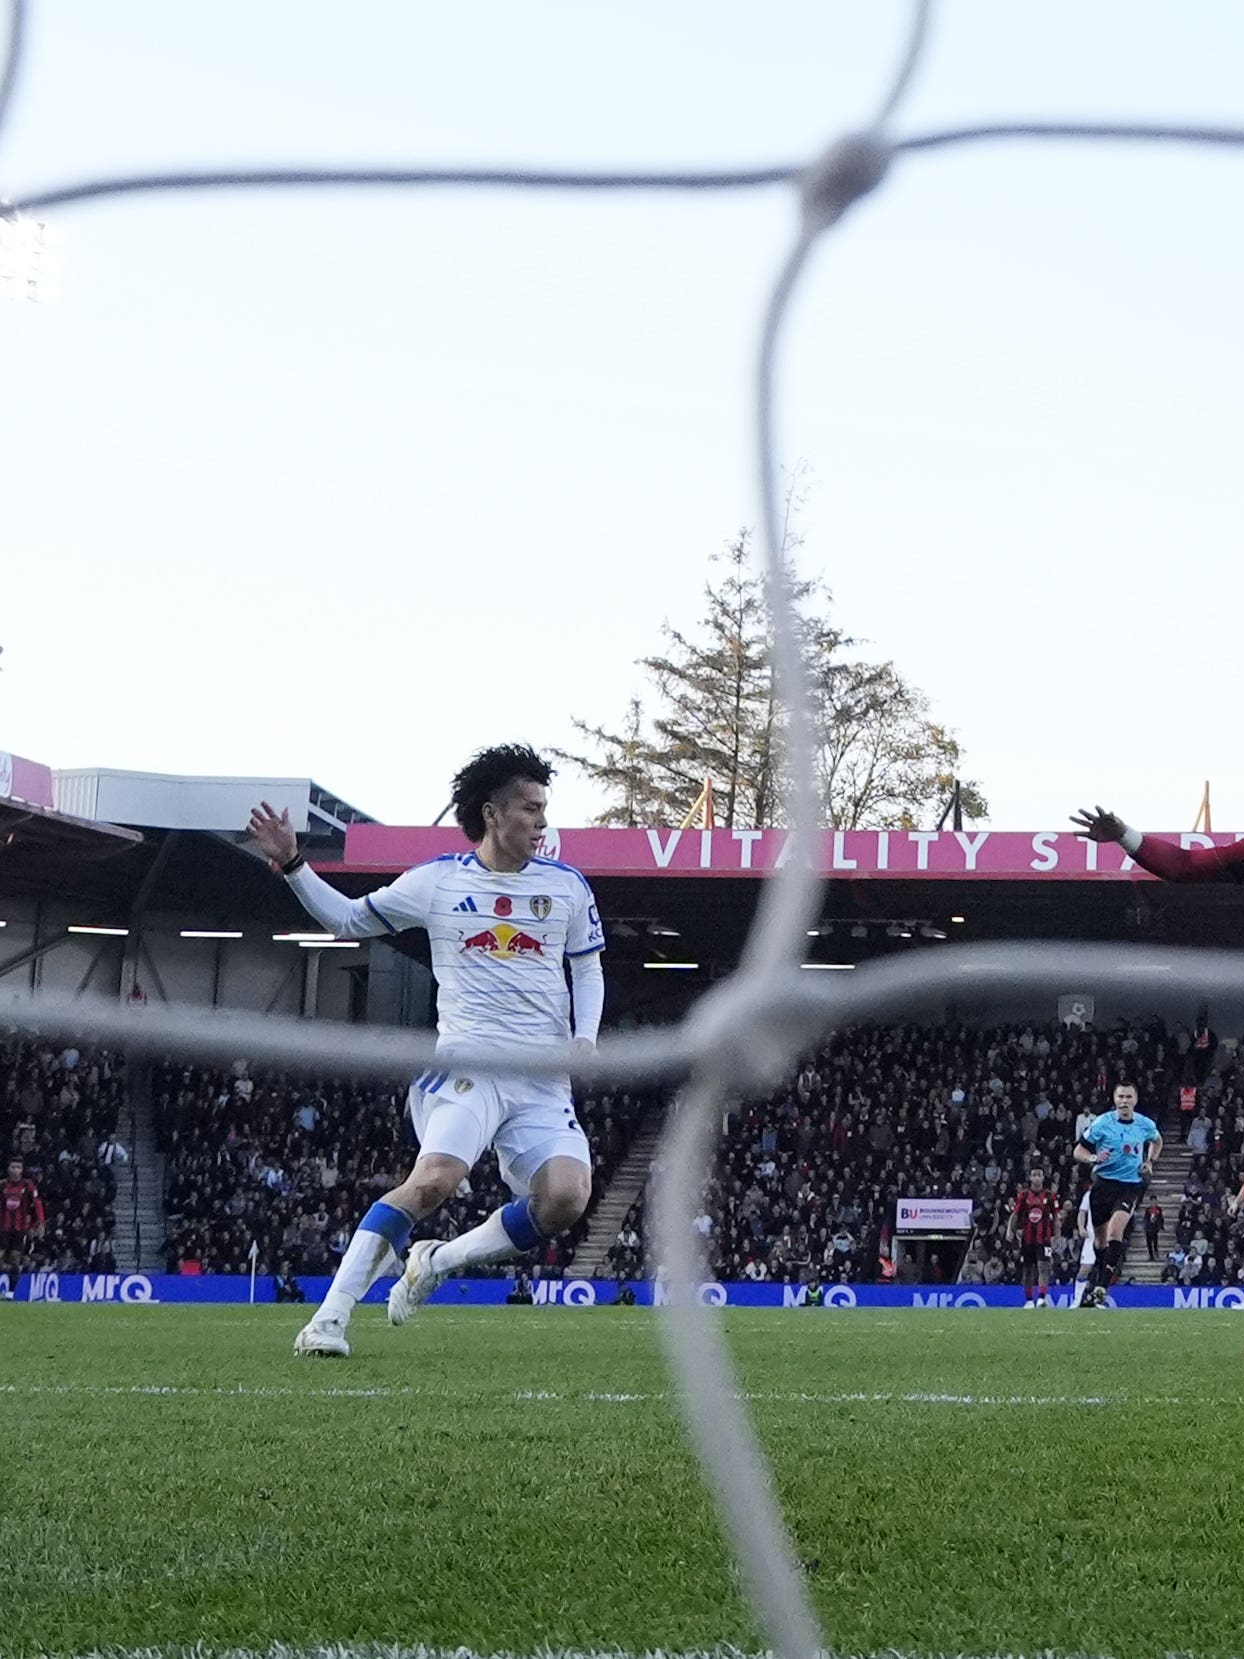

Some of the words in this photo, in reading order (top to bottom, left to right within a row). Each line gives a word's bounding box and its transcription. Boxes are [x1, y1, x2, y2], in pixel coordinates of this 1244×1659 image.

[901, 1208, 918, 1220] BU
[29, 1273, 61, 1302] MrQ
[82, 1274, 160, 1303] MrQ
[783, 1285, 857, 1308] MQ
